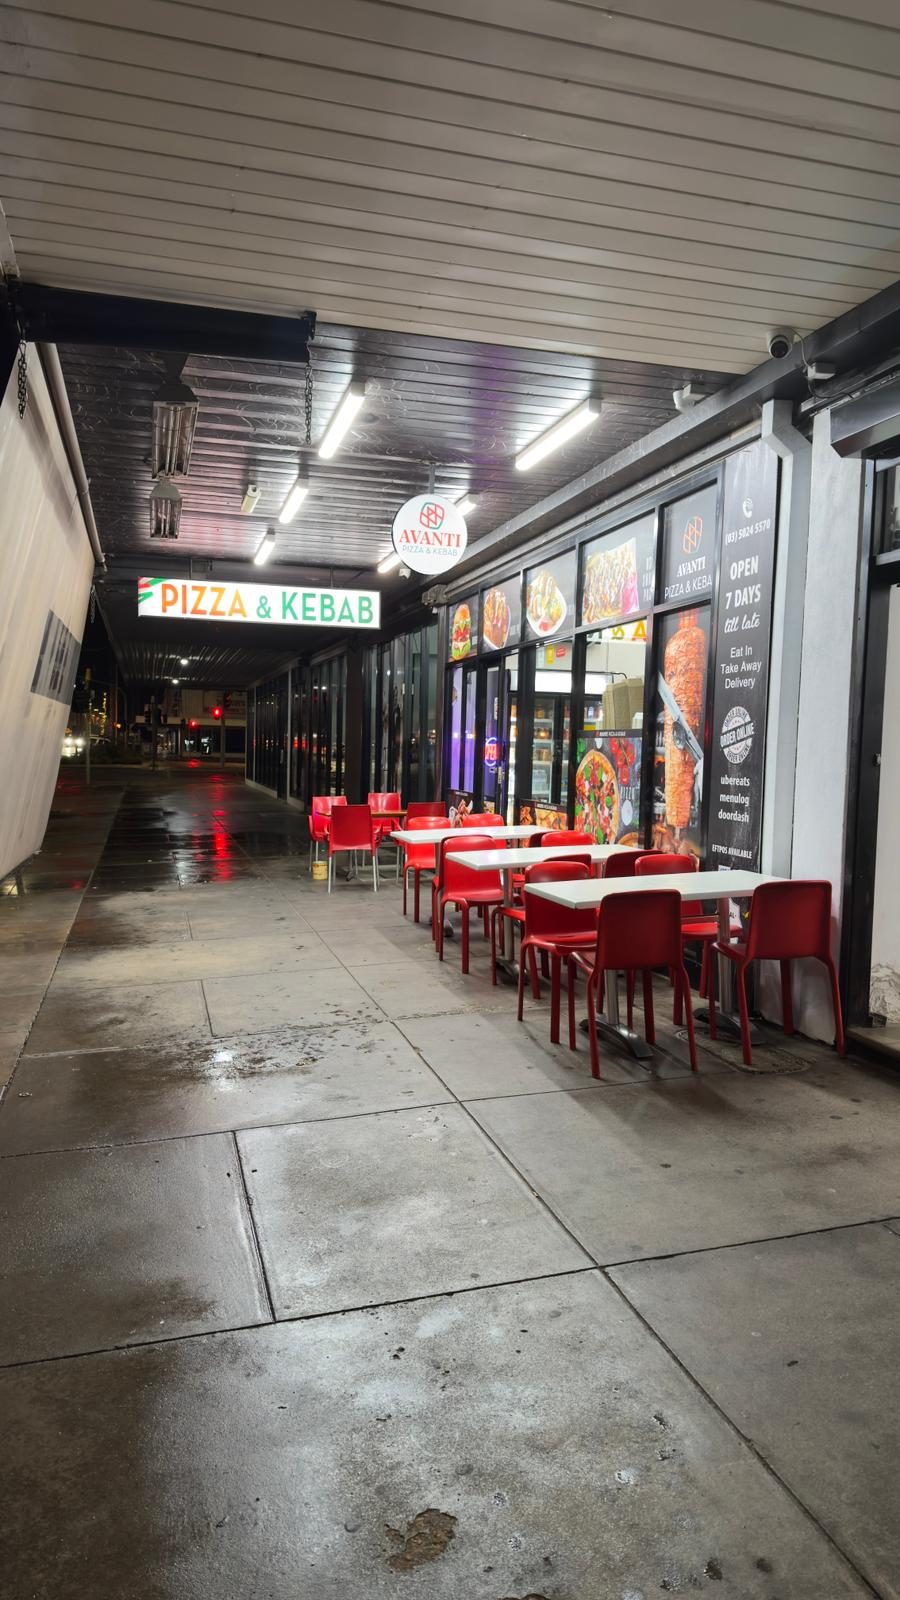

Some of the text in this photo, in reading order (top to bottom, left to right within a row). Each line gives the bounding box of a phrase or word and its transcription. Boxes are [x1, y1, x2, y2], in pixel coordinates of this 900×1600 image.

[399, 529, 461, 547] AVANTI
[725, 518, 771, 544] (03) 5024 5570
[402, 544, 424, 553] PIZZA
[432, 547, 458, 556] KEBAB
[677, 556, 706, 577] AVANTI
[730, 556, 759, 580] OPEN
[664, 583, 684, 599] PIZZA
[685, 580, 692, 593] &
[725, 584, 761, 610] 7 DAYS
[161, 583, 374, 624] PIZZA & KEBAB
[724, 612, 760, 633] till late
[730, 645, 753, 659] Eat In
[720, 661, 762, 675] Take Away
[724, 677, 756, 690] Delivery
[720, 775, 750, 786] ubereats
[719, 793, 750, 807] menulog
[718, 809, 750, 822] doordash
[711, 844, 752, 859] EFTPOS AVAILABLE
